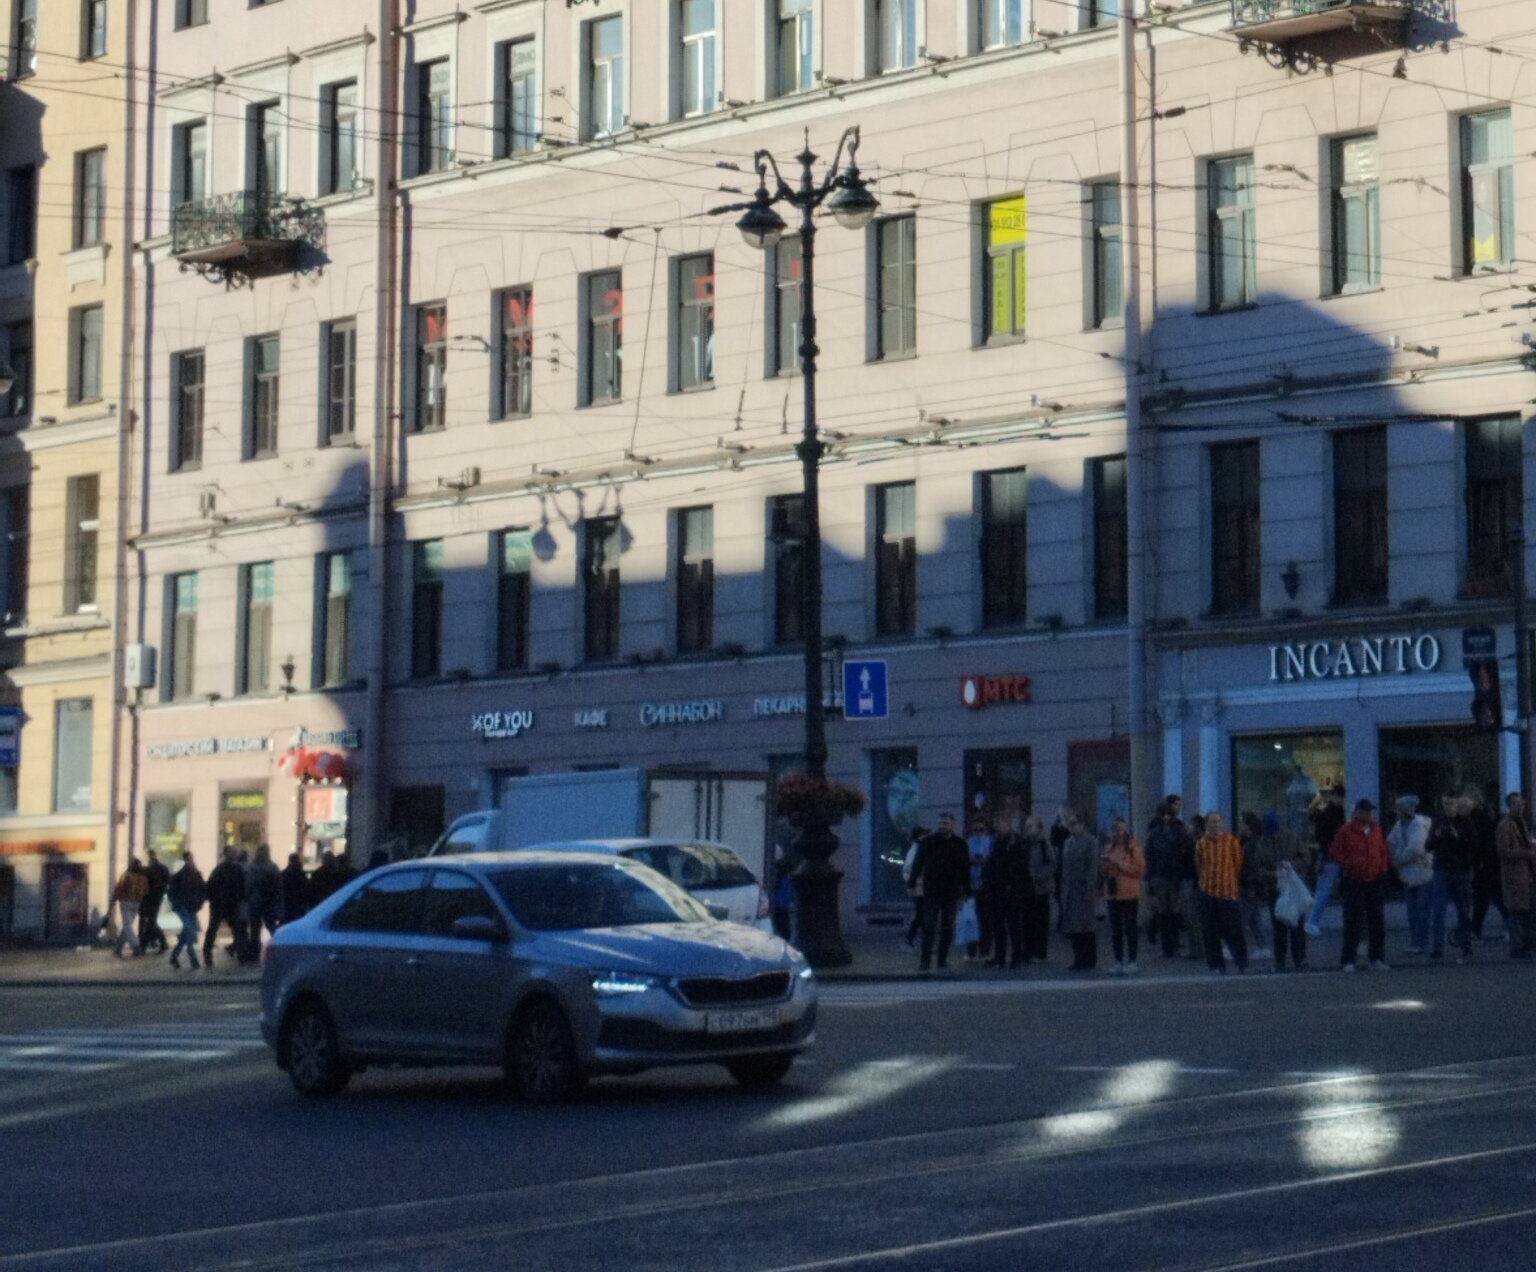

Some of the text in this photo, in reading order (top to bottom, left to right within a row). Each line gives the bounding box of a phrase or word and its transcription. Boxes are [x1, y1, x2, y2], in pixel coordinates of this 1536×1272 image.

[1268, 633, 1440, 681] INCANTO
[982, 675, 1028, 702] МТС
[752, 694, 807, 716] ПЕКАРН
[502, 710, 533, 729] YOU
